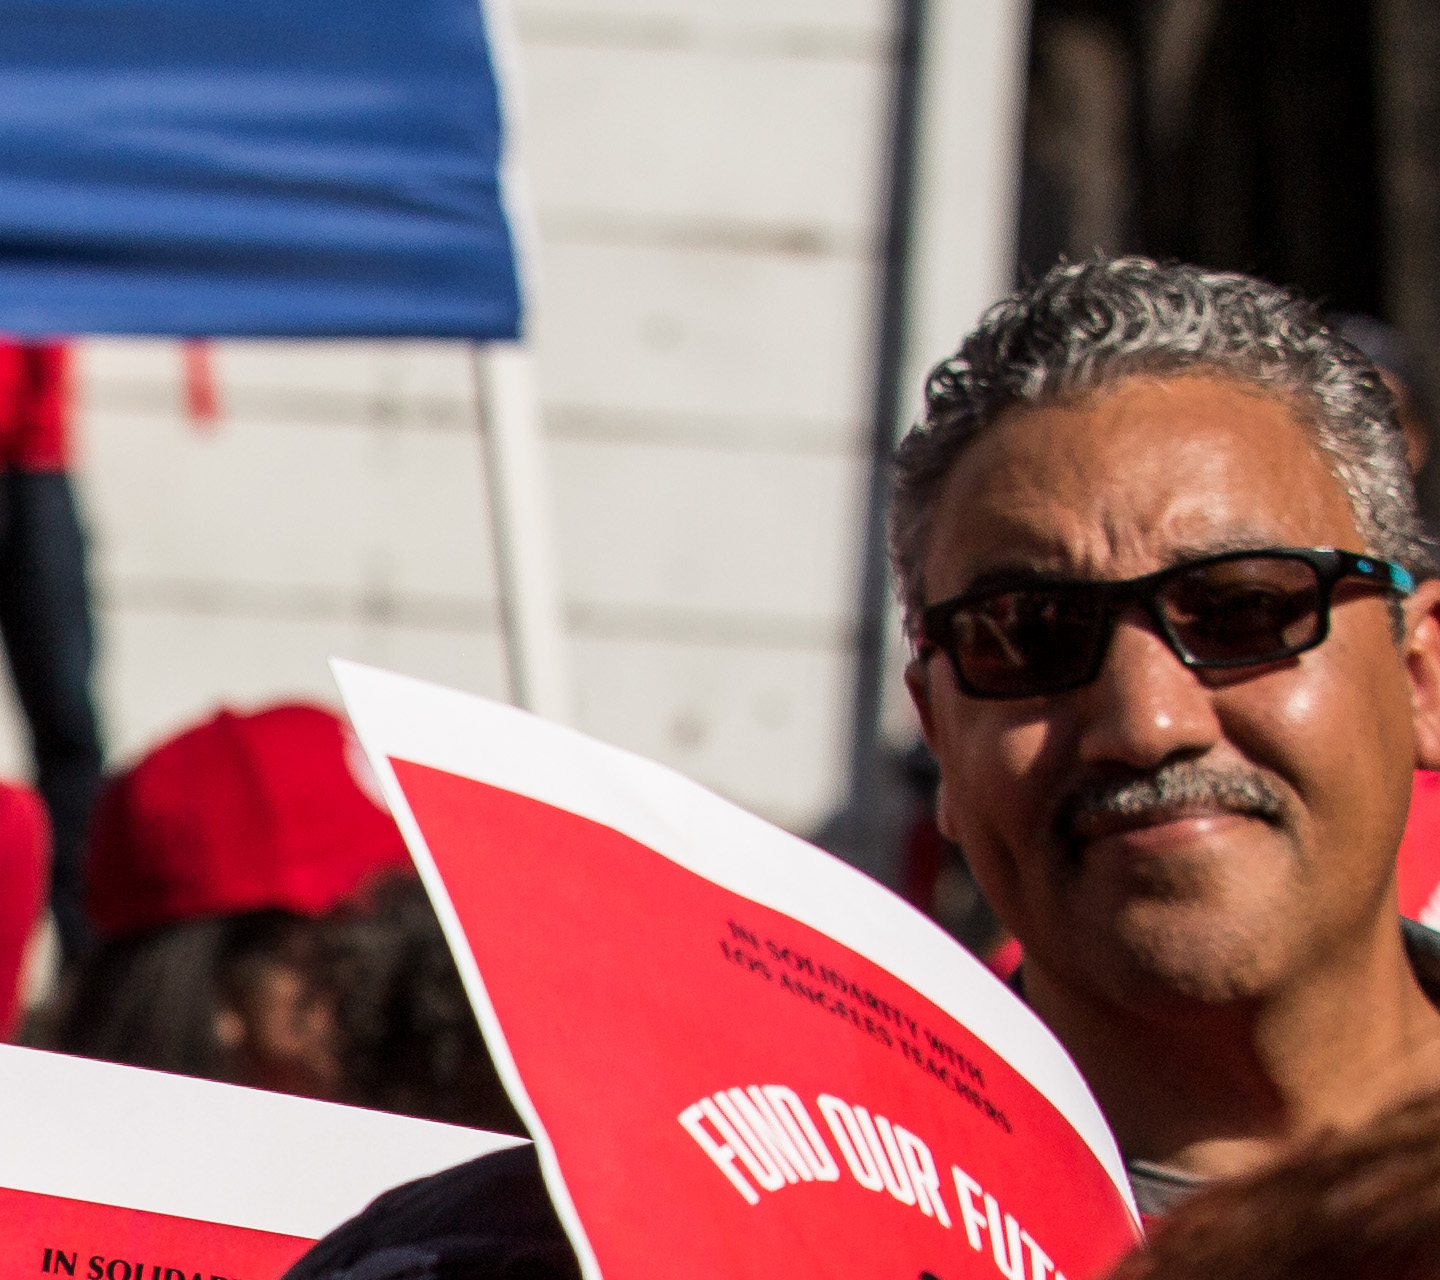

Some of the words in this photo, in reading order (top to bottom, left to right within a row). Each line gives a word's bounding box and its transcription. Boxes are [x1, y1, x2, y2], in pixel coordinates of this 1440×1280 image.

[765, 940, 918, 1039] SOLIDARITY
[780, 973, 894, 1048] ANGELES
[897, 1036, 1014, 1135] TEACHERS
[677, 1085, 840, 1206] FUND
[816, 1093, 953, 1229] OUR
[41, 1248, 78, 1277] IN
